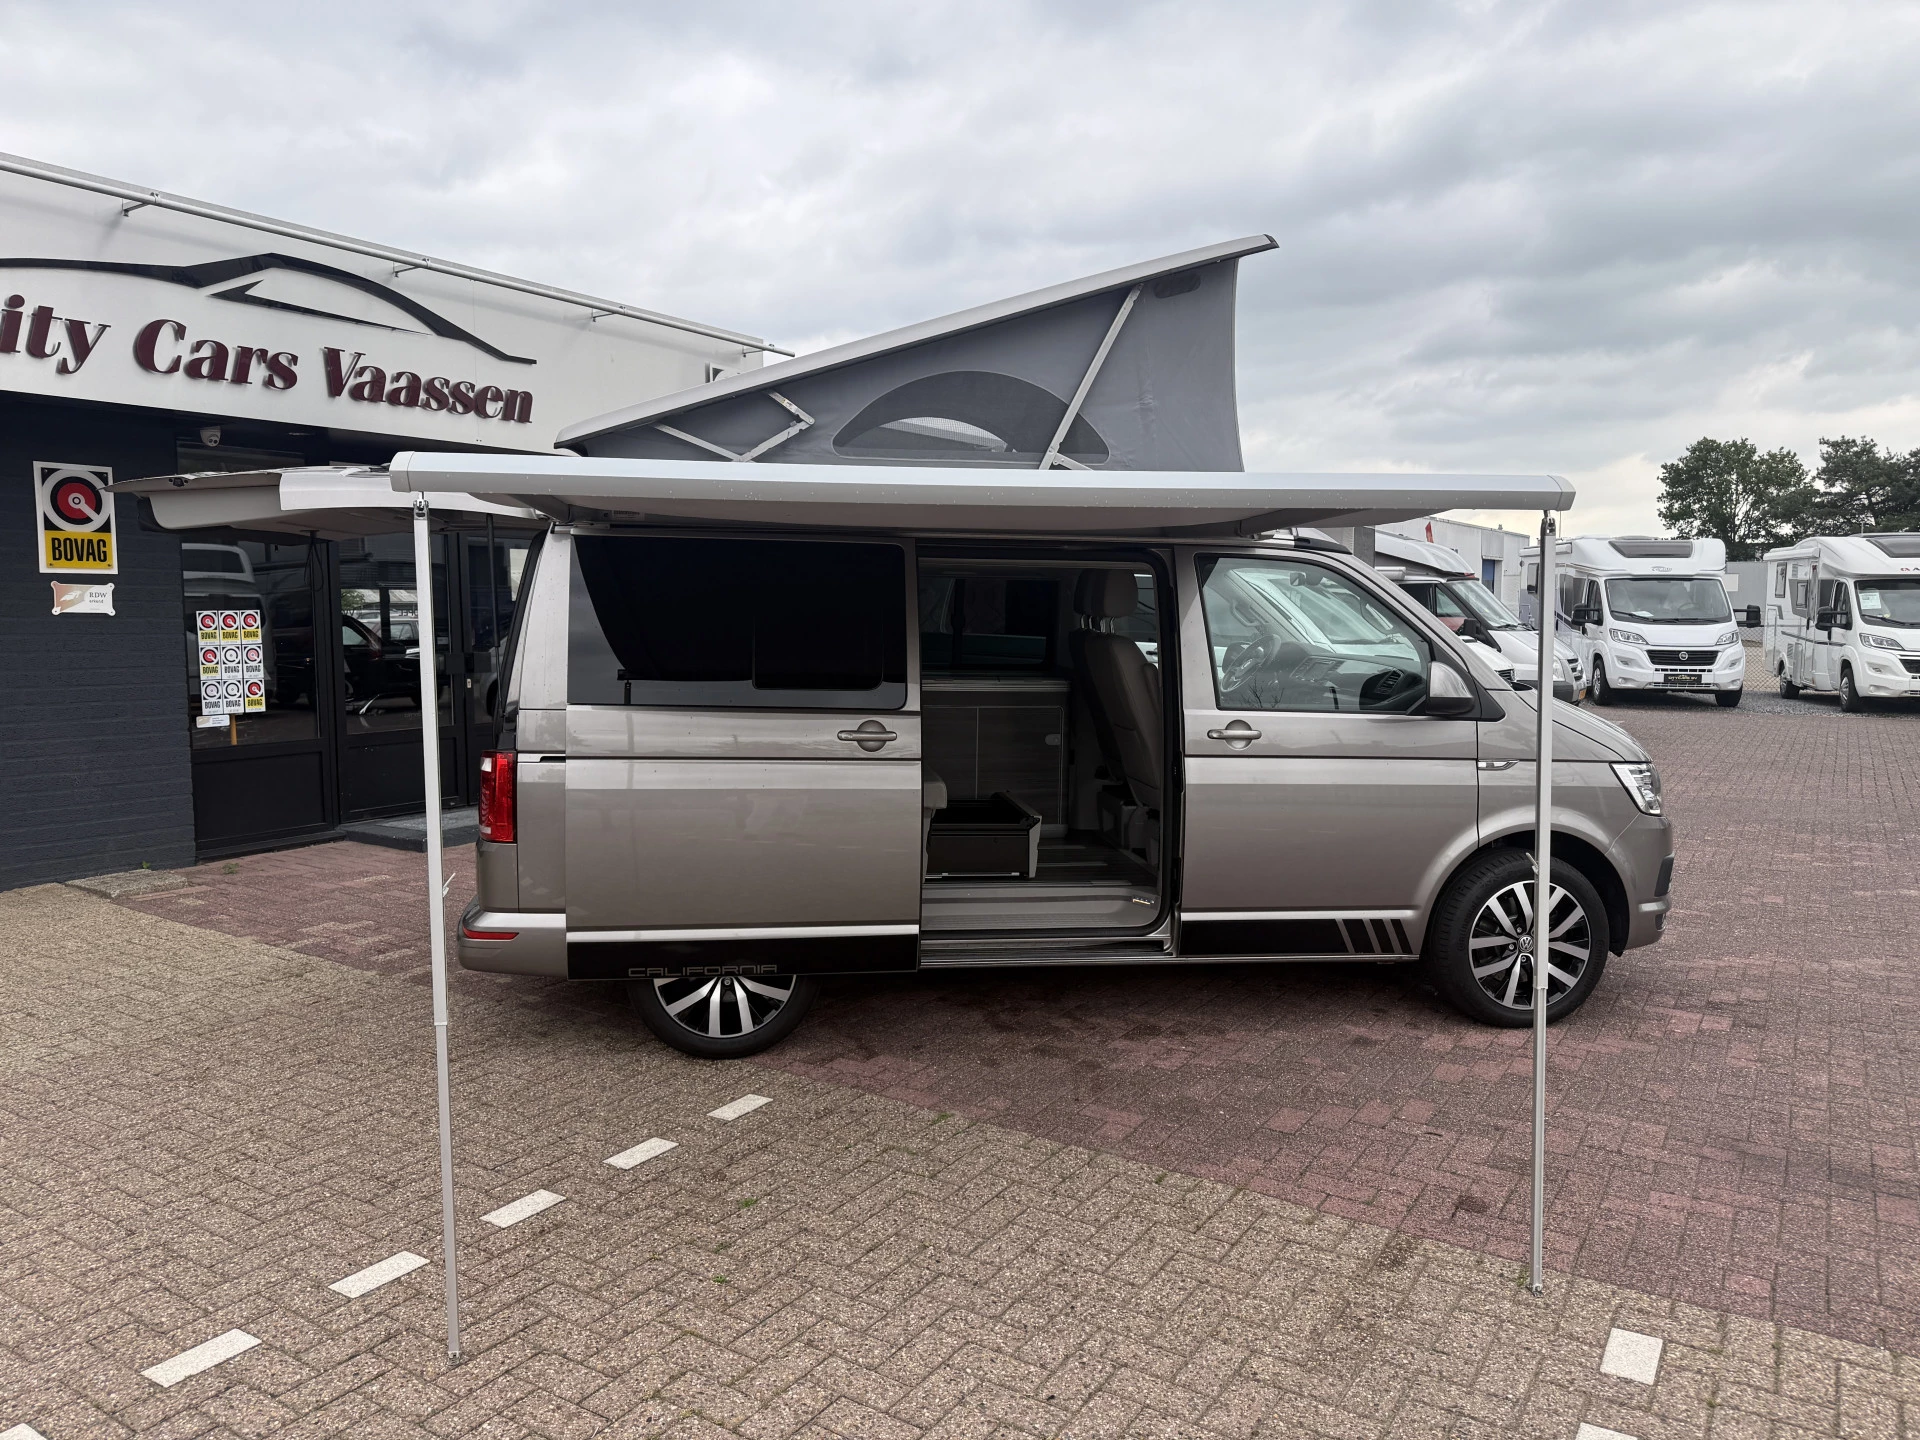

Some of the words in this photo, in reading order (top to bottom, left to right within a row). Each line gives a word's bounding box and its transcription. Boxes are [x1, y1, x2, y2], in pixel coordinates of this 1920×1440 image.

[0, 293, 111, 375] ity
[134, 318, 299, 391] Cars
[323, 346, 535, 424] Vaassen
[52, 538, 107, 562] BOVAG
[201, 631, 217, 640] BOVAG
[222, 631, 238, 639] BOVAG
[243, 630, 259, 639] BOVAG
[202, 666, 218, 674] BOVAG
[224, 665, 240, 674] BOVAG
[246, 665, 261, 674] BOVAG
[205, 701, 220, 709] BOVAG
[225, 700, 240, 708] BOVAG
[247, 699, 262, 707] BOVAG
[628, 965, 777, 977] CALIFORNIA
